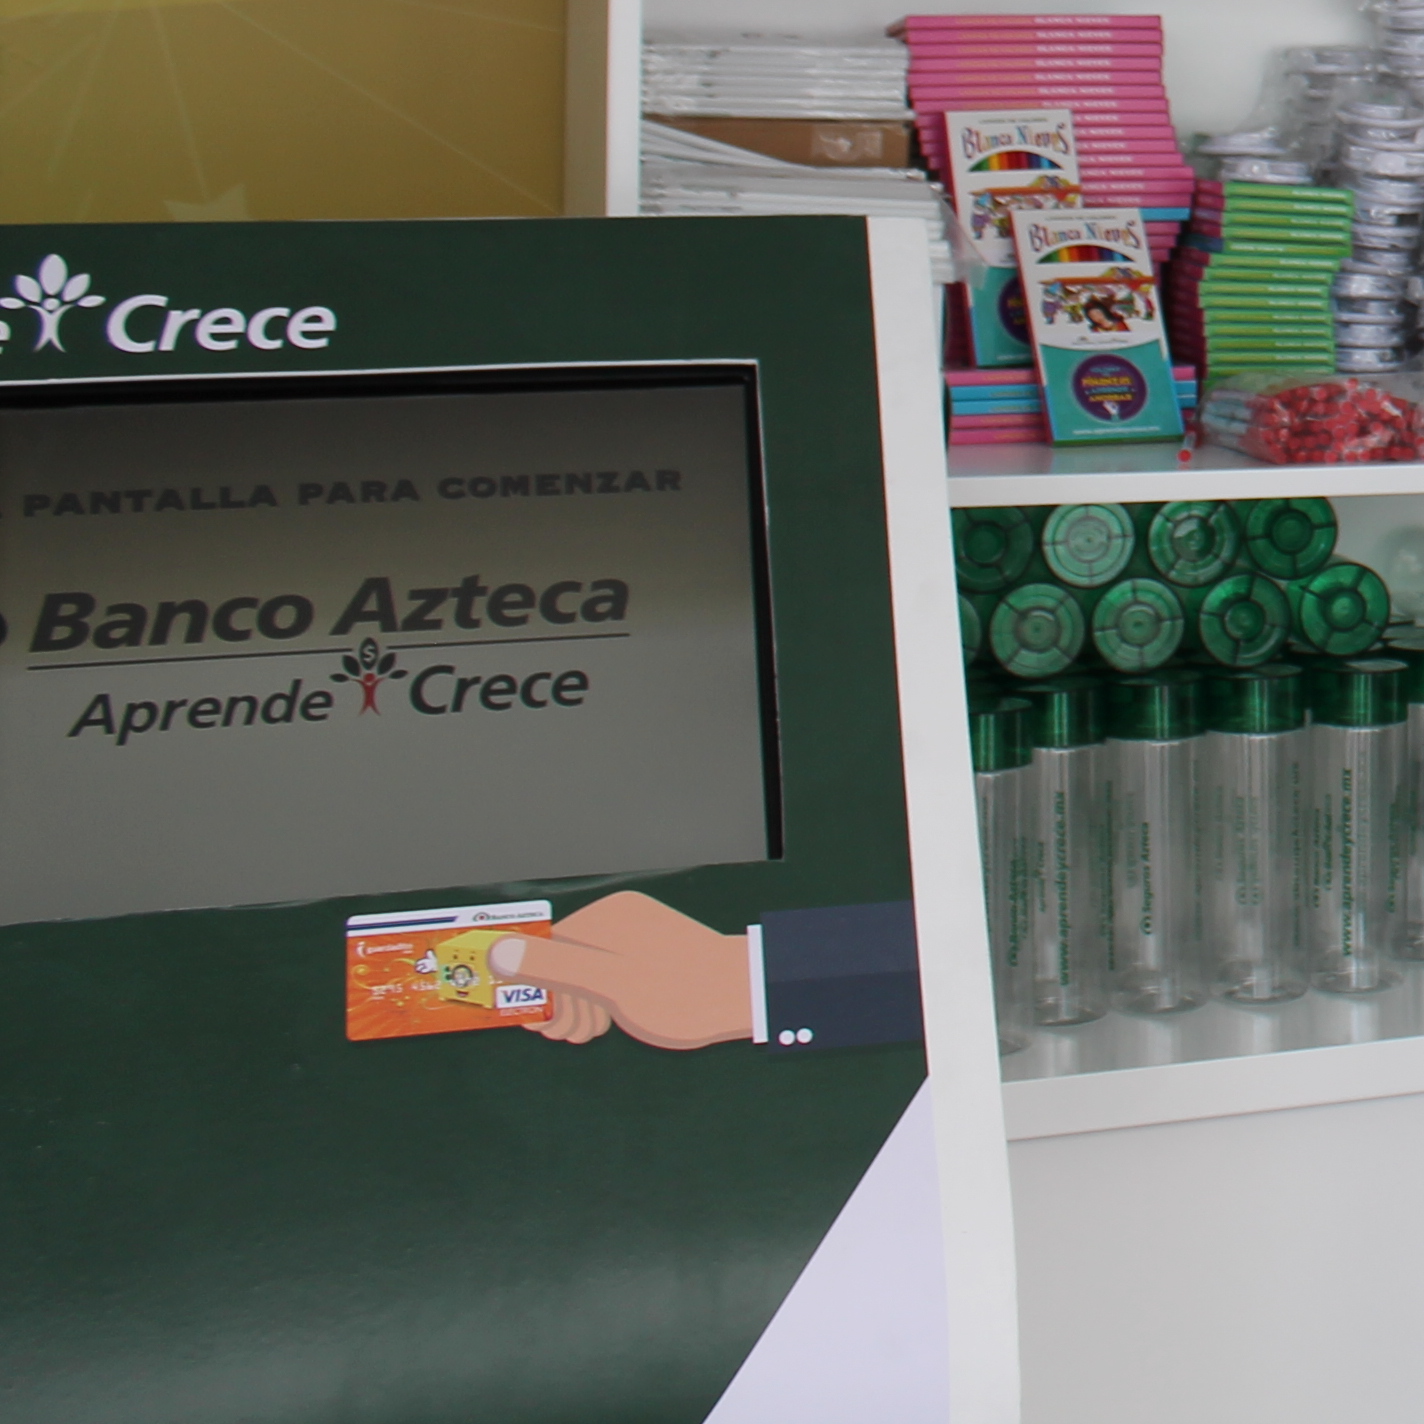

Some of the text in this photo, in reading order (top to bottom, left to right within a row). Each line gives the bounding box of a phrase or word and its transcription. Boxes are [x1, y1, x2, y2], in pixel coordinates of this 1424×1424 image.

[105, 293, 336, 353] Crece
[22, 468, 683, 518] PANTALLA PARA COMENZAR
[28, 575, 629, 653] Banco Azteca
[67, 664, 590, 746] Aprende Crece
[1053, 791, 1071, 987] www.aprendeycrece.mx
[1340, 768, 1355, 956] www.aprendeycrece.mx
[503, 988, 545, 1003] VISA
